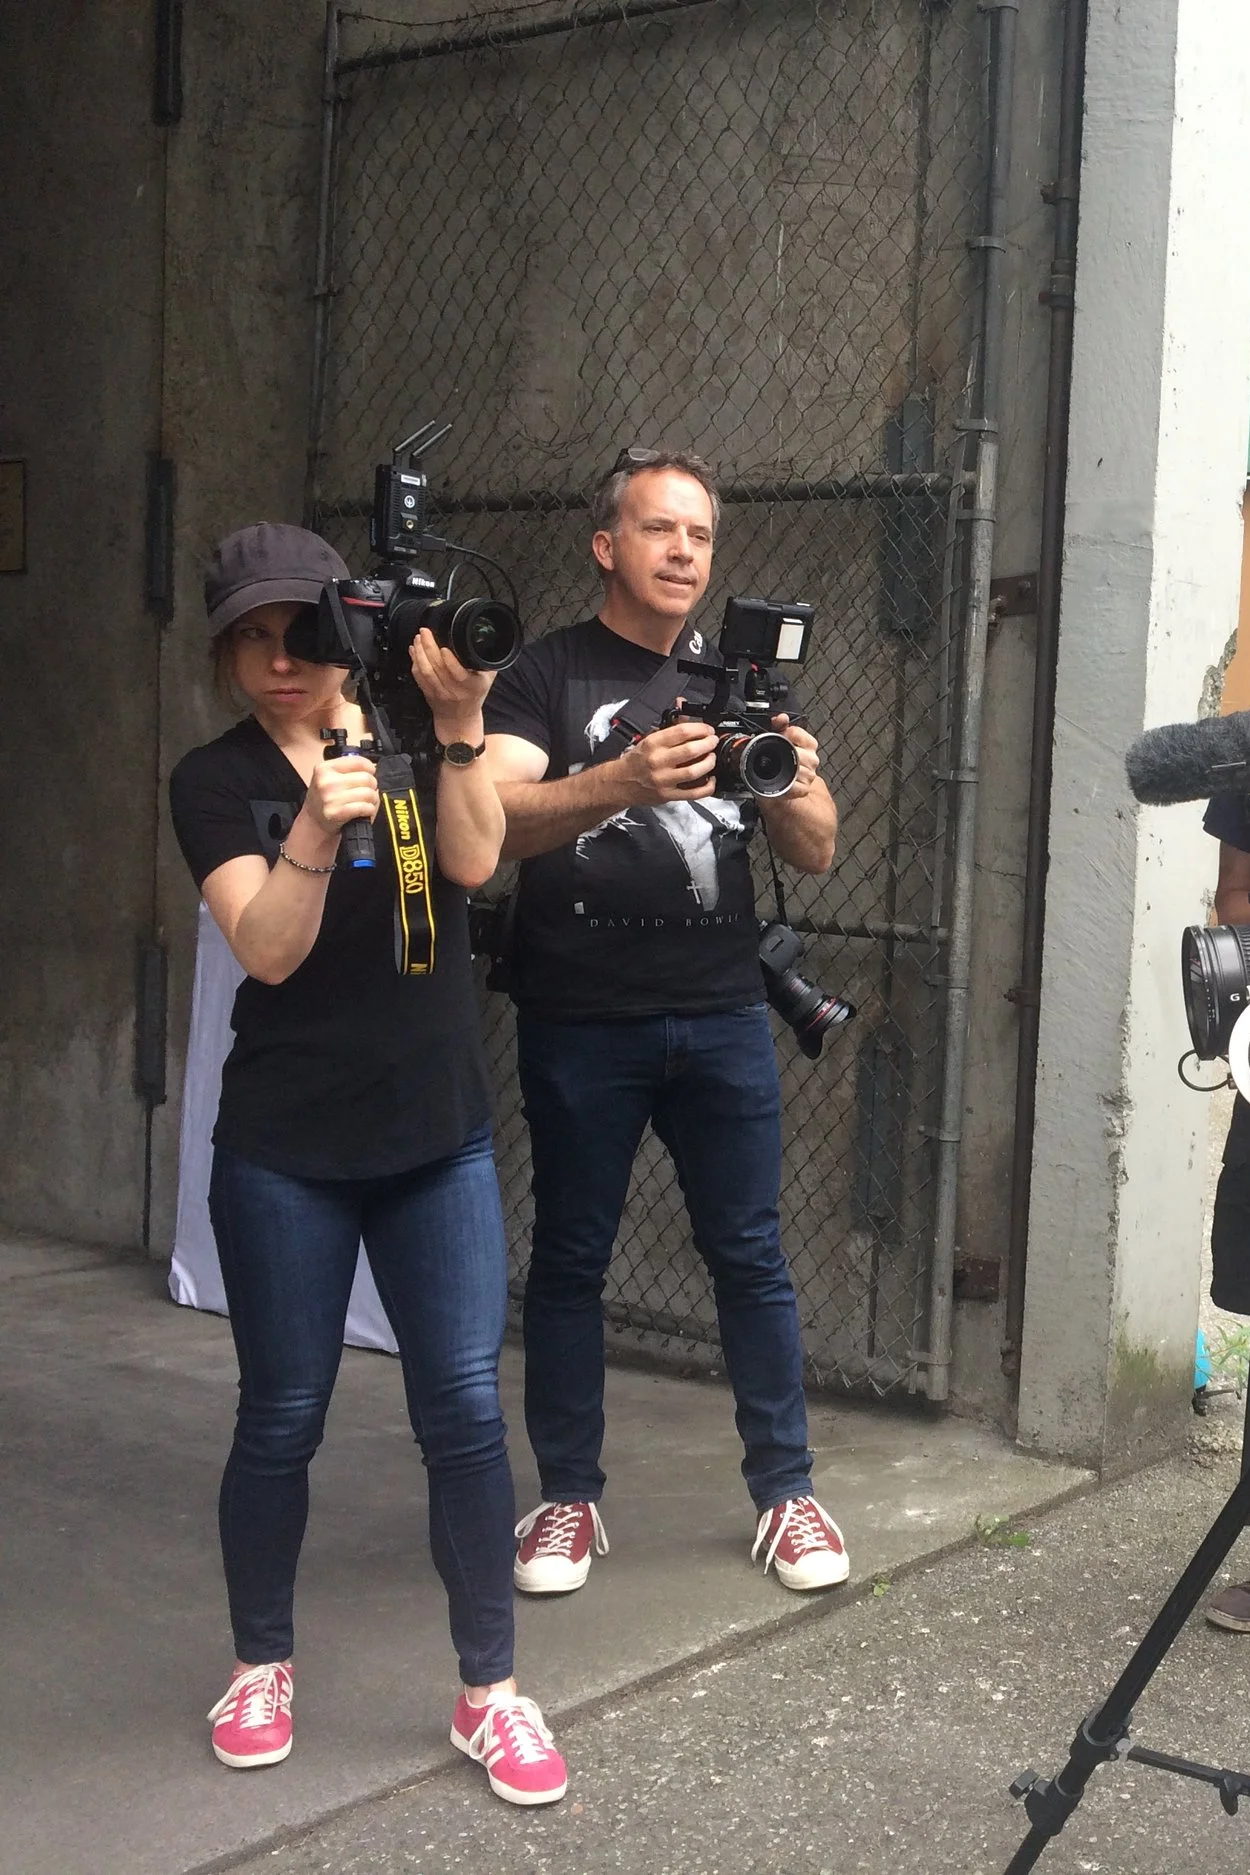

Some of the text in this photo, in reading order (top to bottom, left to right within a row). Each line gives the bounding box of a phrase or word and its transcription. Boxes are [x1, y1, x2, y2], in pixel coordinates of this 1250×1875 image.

[412, 577, 435, 588] Nikon
[393, 799, 424, 894] Nikon D850
[590, 918, 664, 928] DAVID
[1229, 993, 1240, 1001] G
